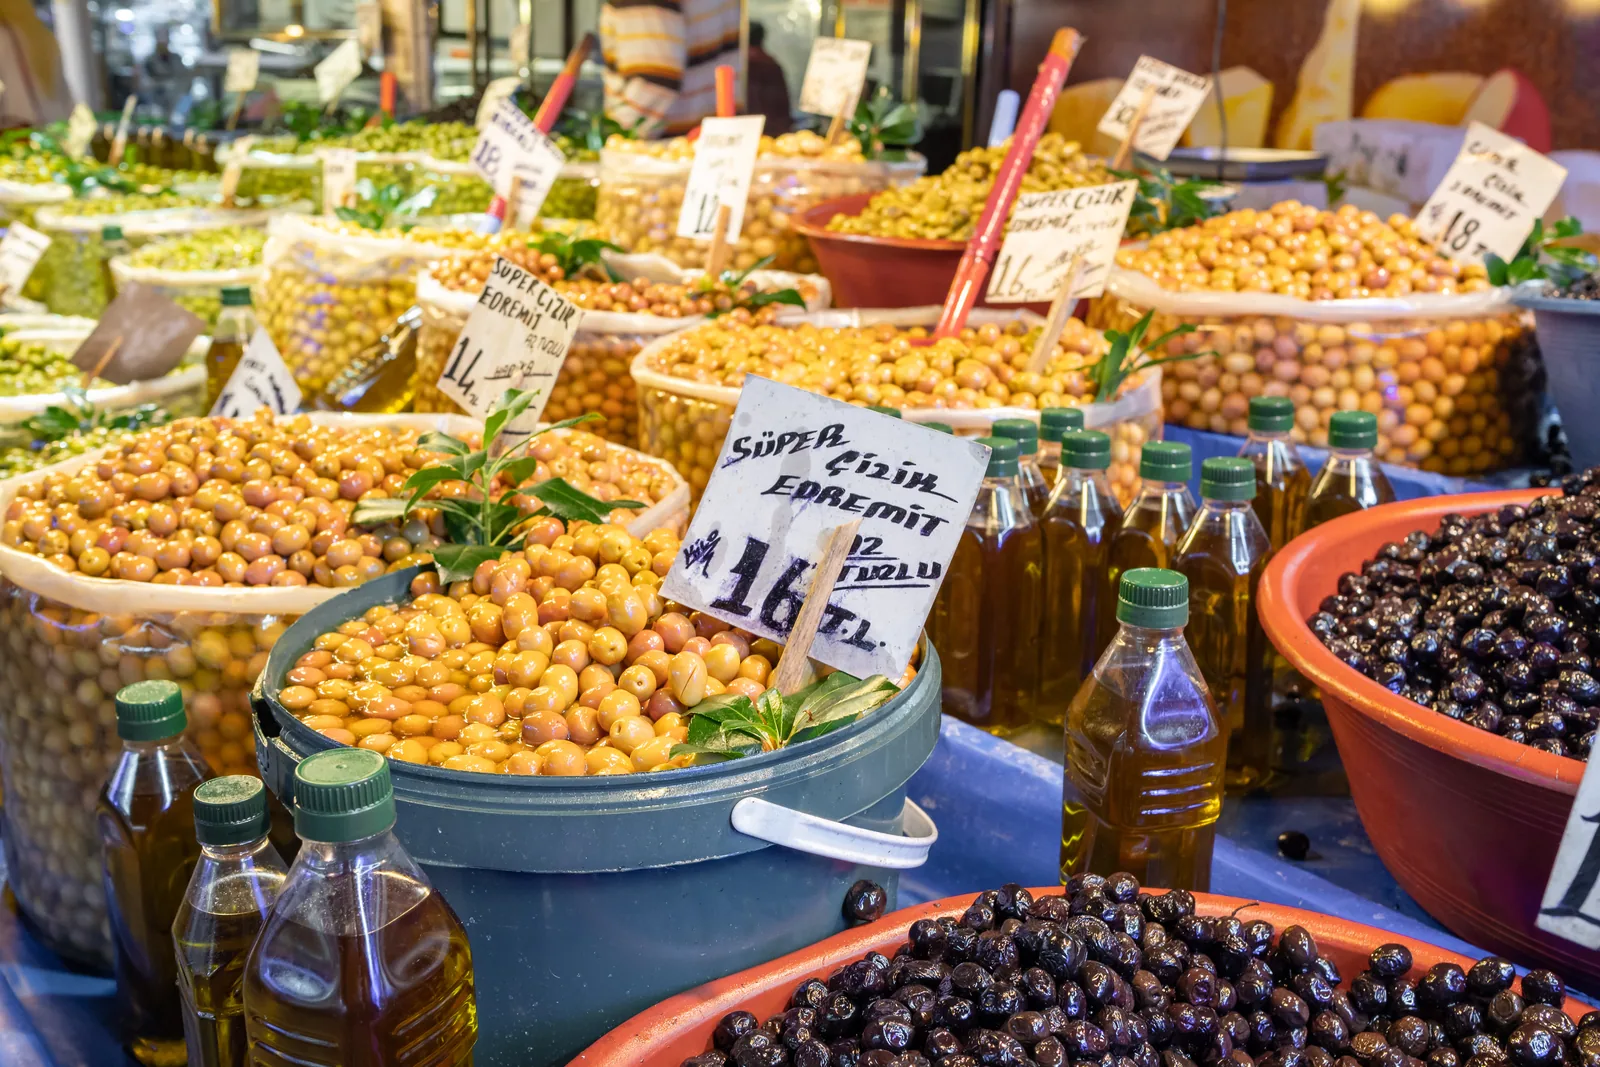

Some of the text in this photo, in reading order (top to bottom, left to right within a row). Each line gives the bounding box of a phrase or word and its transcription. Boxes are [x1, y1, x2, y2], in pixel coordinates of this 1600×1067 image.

[474, 140, 502, 176] 18
[1443, 210, 1480, 251] 18
[987, 255, 1032, 297] 16
[444, 337, 484, 396] 14
[721, 423, 850, 468] SÜPER
[825, 450, 959, 504] ÇİZİK
[760, 475, 950, 537] EDREMİT
[709, 536, 806, 638] 16
[836, 561, 942, 582] TUZLU
